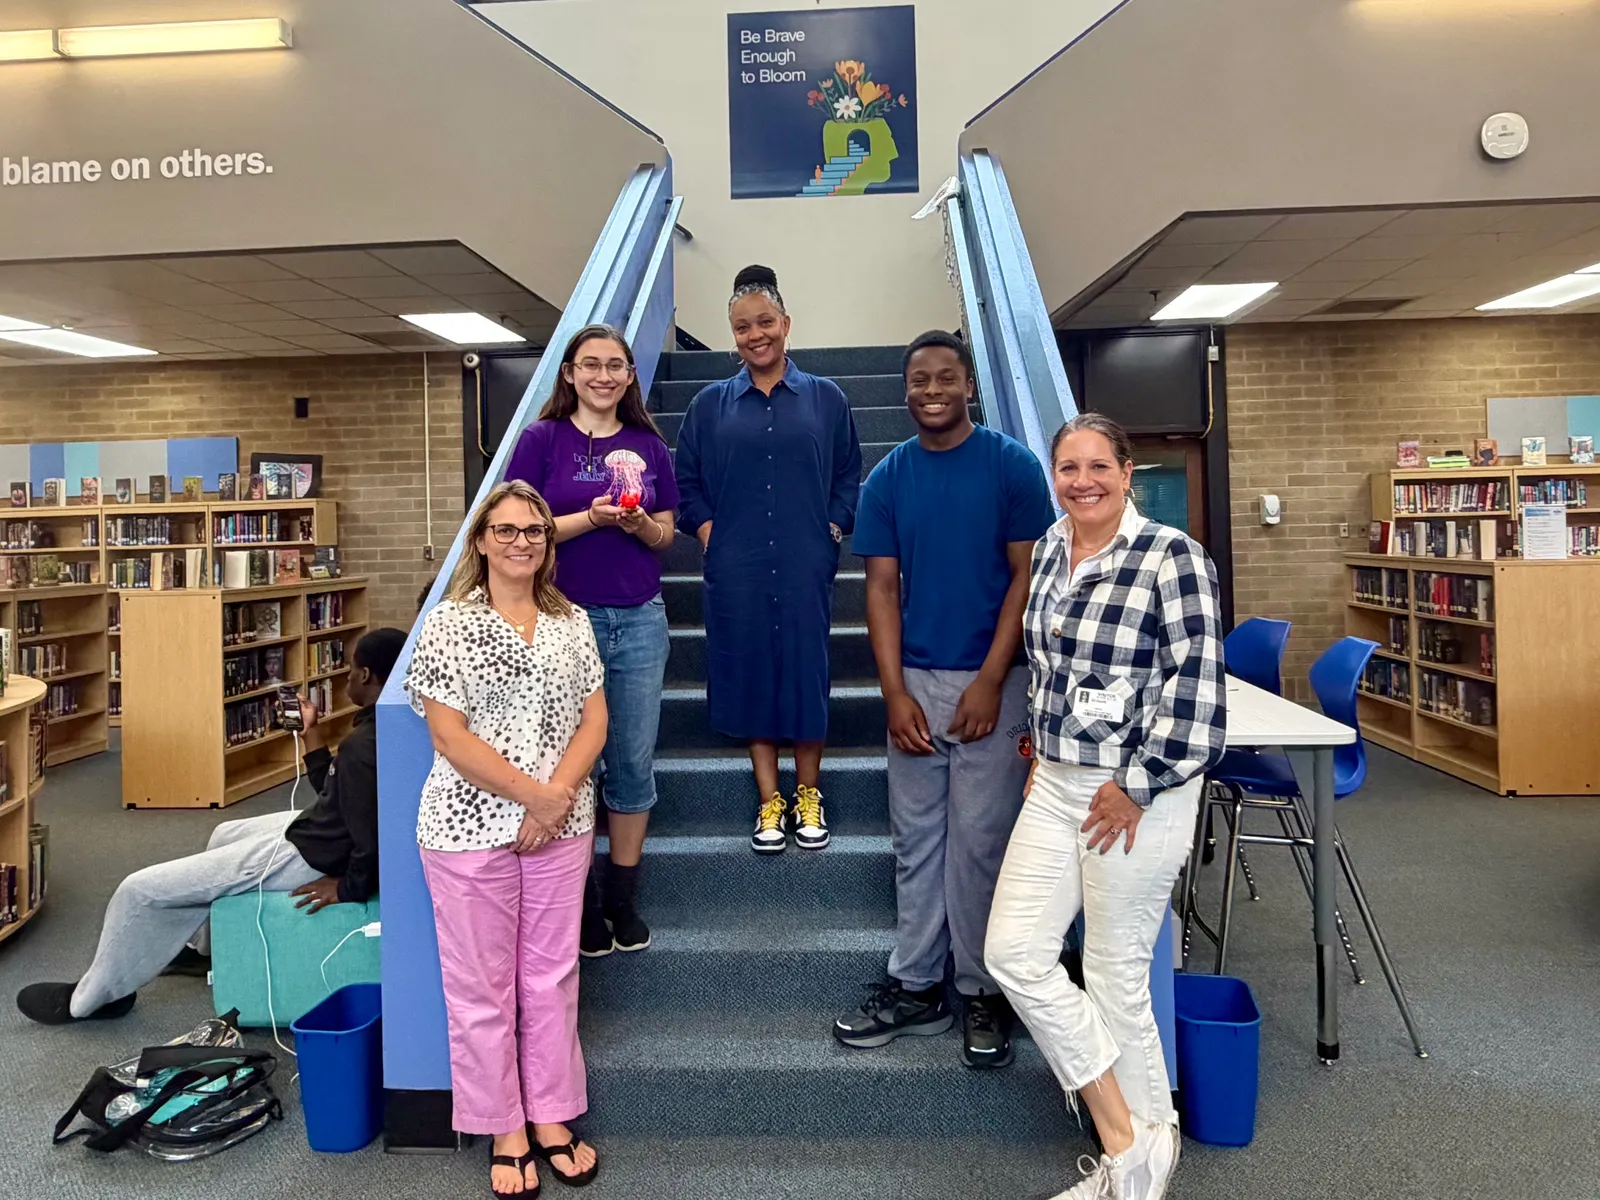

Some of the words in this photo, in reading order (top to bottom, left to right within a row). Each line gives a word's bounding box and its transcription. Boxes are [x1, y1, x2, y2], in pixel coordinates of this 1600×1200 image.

[740, 30, 761, 44] Be
[765, 29, 806, 43] Brave
[741, 48, 796, 65] Enough
[741, 71, 756, 84] to
[759, 69, 806, 83] Bloom
[2, 156, 102, 186] blame
[110, 157, 151, 181] on
[160, 148, 274, 179] others.
[573, 471, 605, 482] JELLY
[1006, 722, 1029, 739] ORIO
